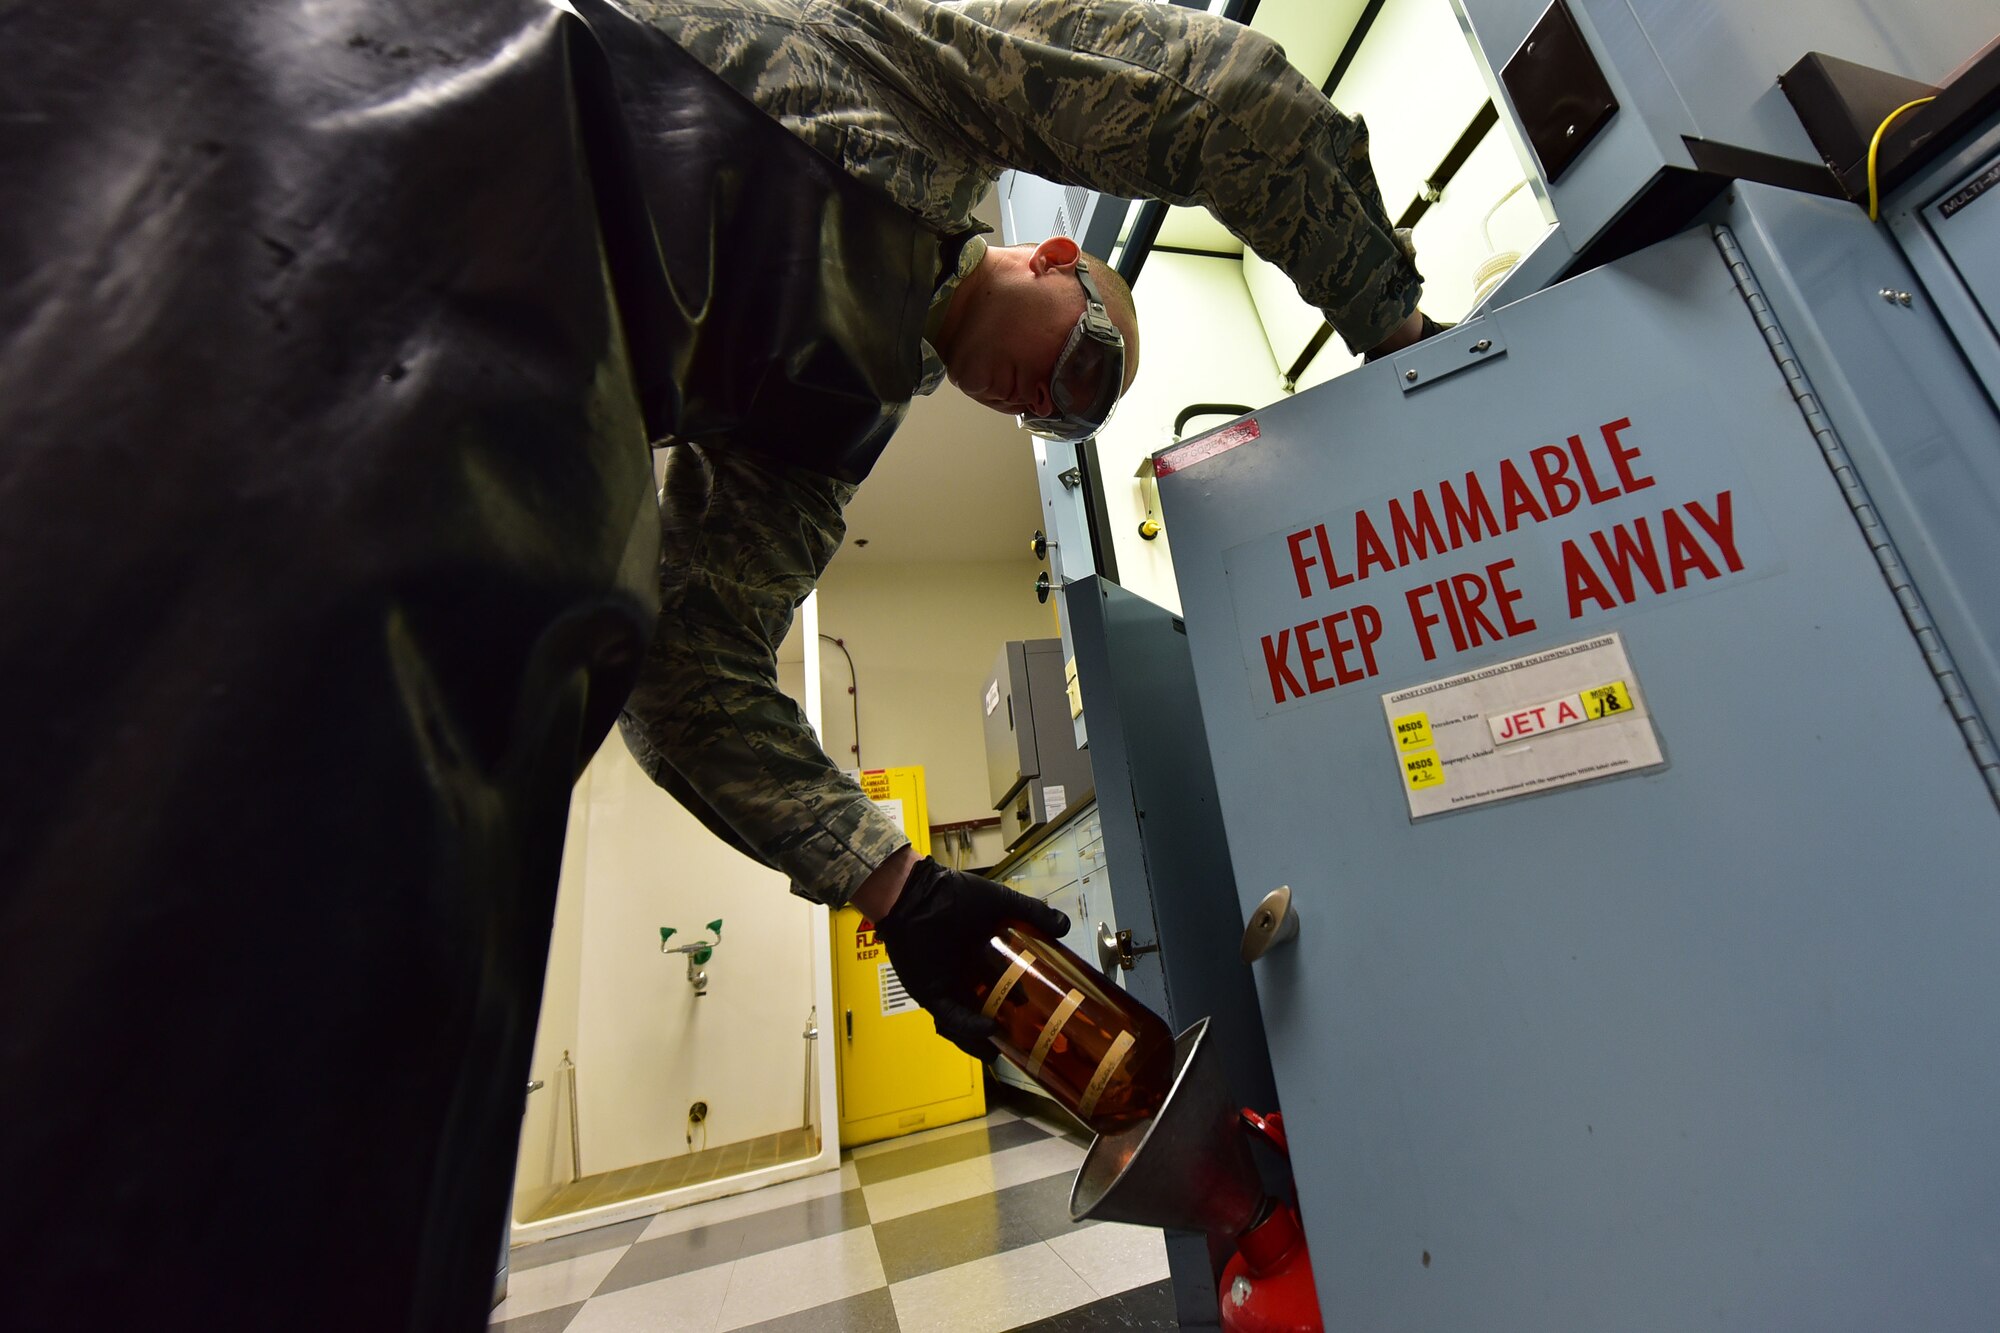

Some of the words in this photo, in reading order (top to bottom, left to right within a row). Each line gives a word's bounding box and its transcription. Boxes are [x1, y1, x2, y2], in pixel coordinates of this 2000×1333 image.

[1287, 416, 1655, 599] FLAMMABLE
[1261, 605, 1382, 704] KEEP
[1405, 558, 1537, 661] FIRE
[1562, 490, 1745, 619] AWAY
[1419, 683, 1444, 695] COULD
[1509, 660, 1524, 670] THE
[1524, 648, 1568, 666] FOLLOWING
[1590, 686, 1615, 699] MSDS
[1462, 712, 1479, 721] Ether
[1500, 707, 1546, 739] JET
[1558, 701, 1578, 724] A
[1398, 720, 1422, 733] MSDS
[1408, 758, 1433, 771] MSDS
[857, 949, 879, 961] KEEP
